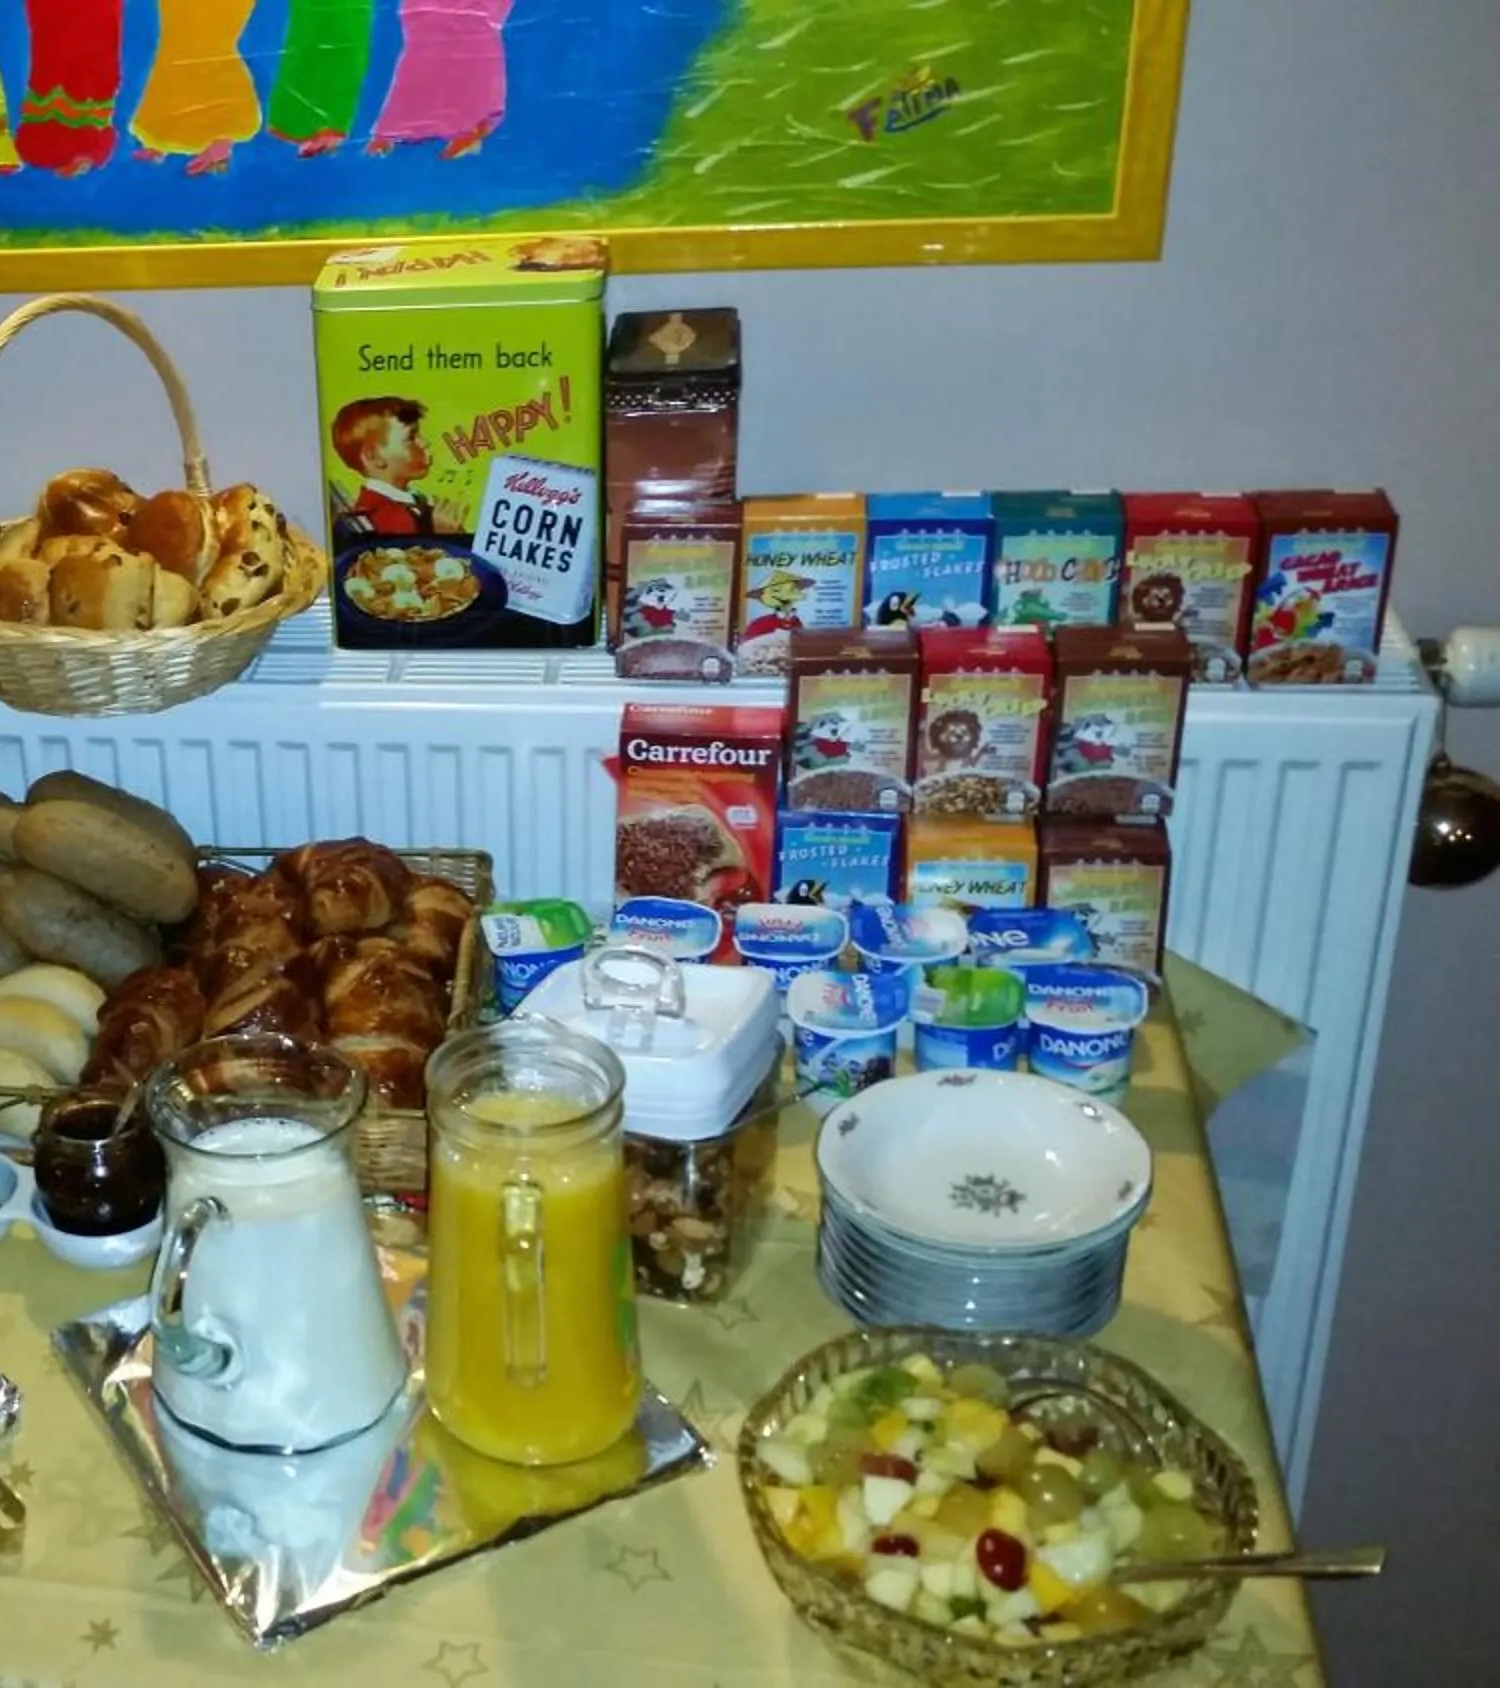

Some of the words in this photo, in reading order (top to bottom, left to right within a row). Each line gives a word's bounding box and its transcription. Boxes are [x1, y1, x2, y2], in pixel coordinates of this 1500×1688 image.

[358, 344, 414, 372] Send
[426, 343, 483, 370] them
[496, 341, 553, 369] back
[441, 375, 572, 465] HAPPY!
[504, 472, 582, 506] Kellogg's
[492, 499, 583, 548] CORN
[485, 531, 573, 573] FLAKES
[801, 550, 857, 567] WHEAT
[627, 739, 773, 765] Carrefour
